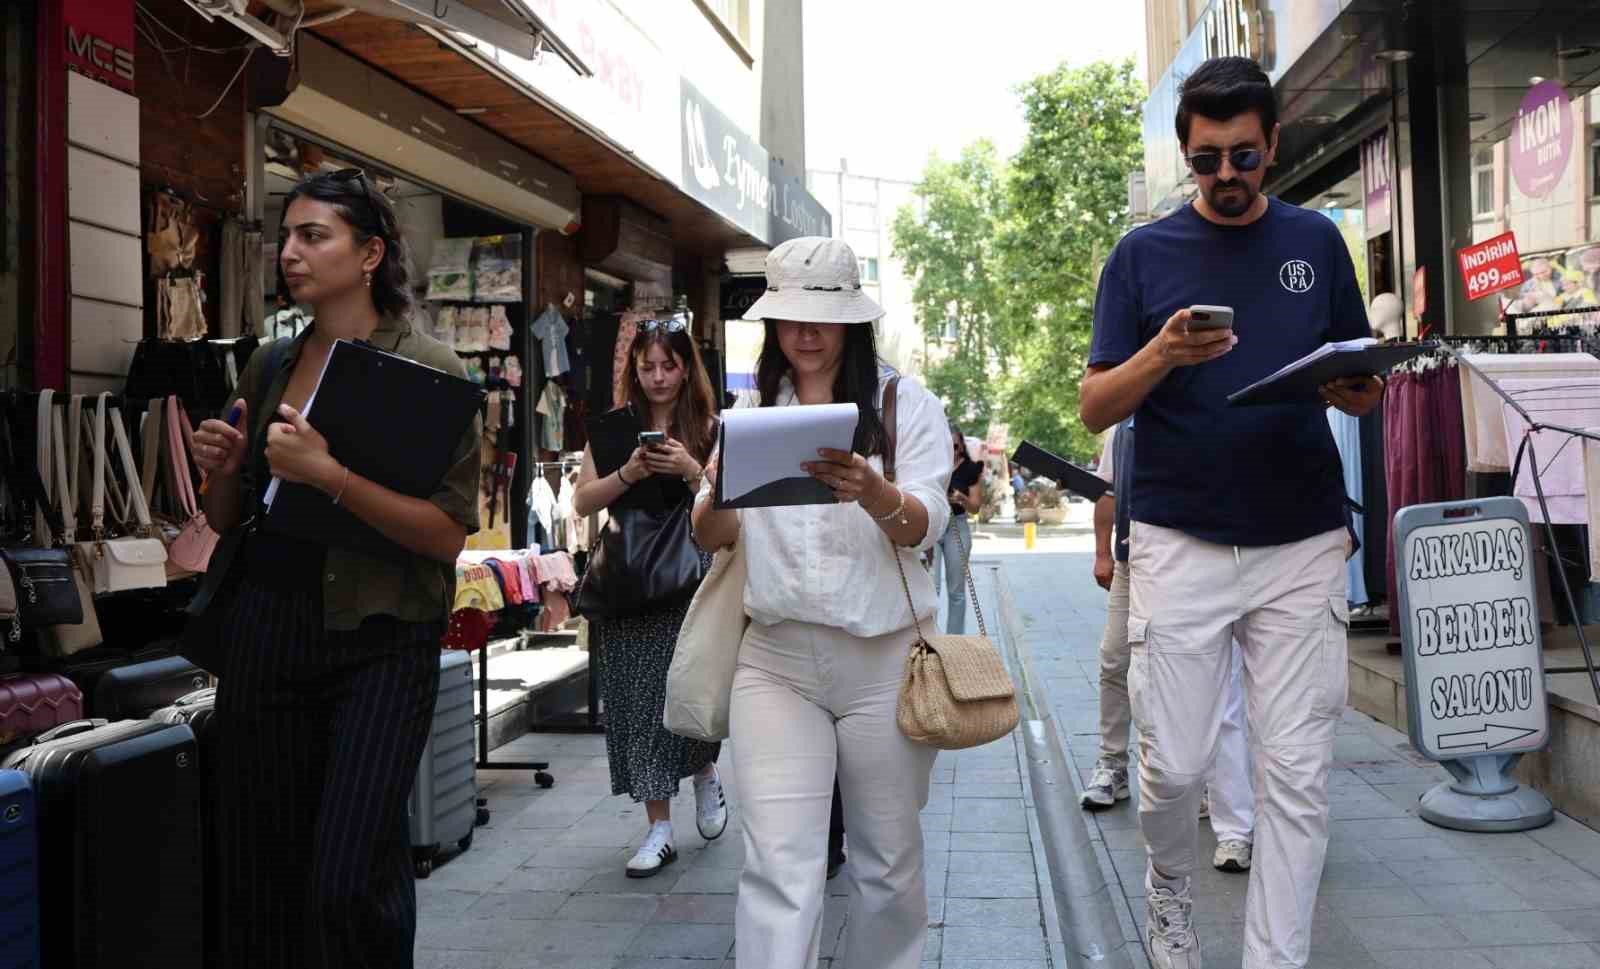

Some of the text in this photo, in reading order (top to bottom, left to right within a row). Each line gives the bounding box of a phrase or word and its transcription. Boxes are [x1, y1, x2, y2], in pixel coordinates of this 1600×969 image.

[1519, 96, 1560, 152] İKON
[723, 135, 778, 216] Eymen
[1288, 263, 1305, 276] US
[1461, 239, 1514, 270] İNDİRİM
[1290, 276, 1307, 289] PA
[1410, 528, 1525, 580] ARKADAŞ
[1417, 598, 1534, 656] BERBER
[1431, 667, 1532, 720] SALONU
